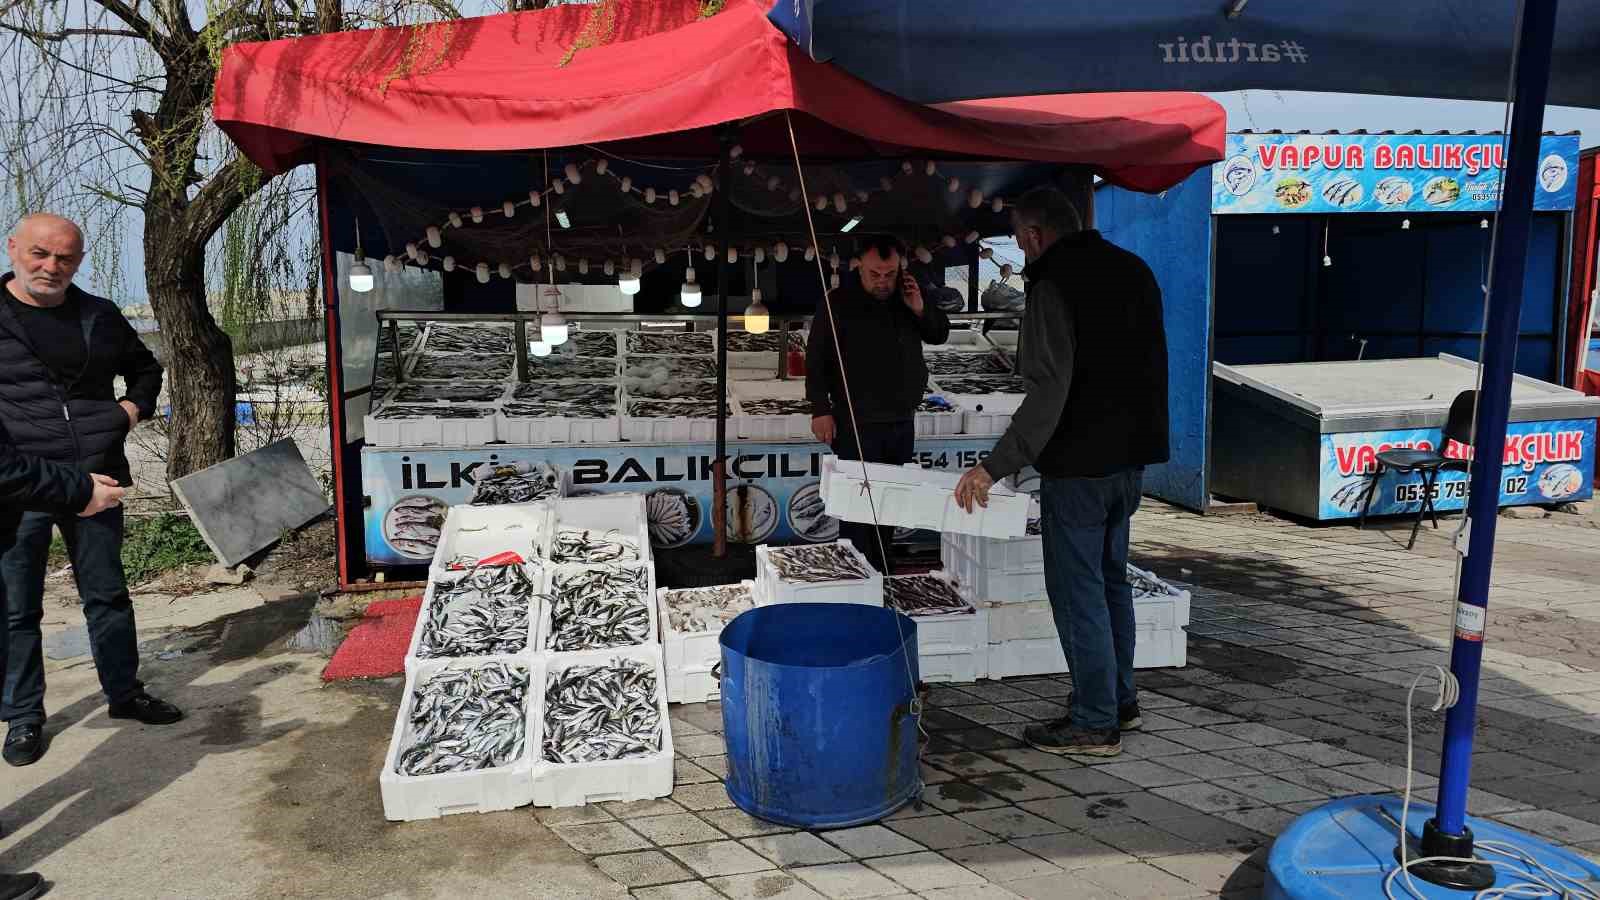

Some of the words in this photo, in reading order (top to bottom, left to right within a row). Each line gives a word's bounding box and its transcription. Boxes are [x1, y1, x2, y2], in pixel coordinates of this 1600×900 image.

[1258, 143, 1365, 171] VAPUR
[1373, 143, 1507, 175] BALIKÇIL
[1506, 476, 1526, 494] 02
